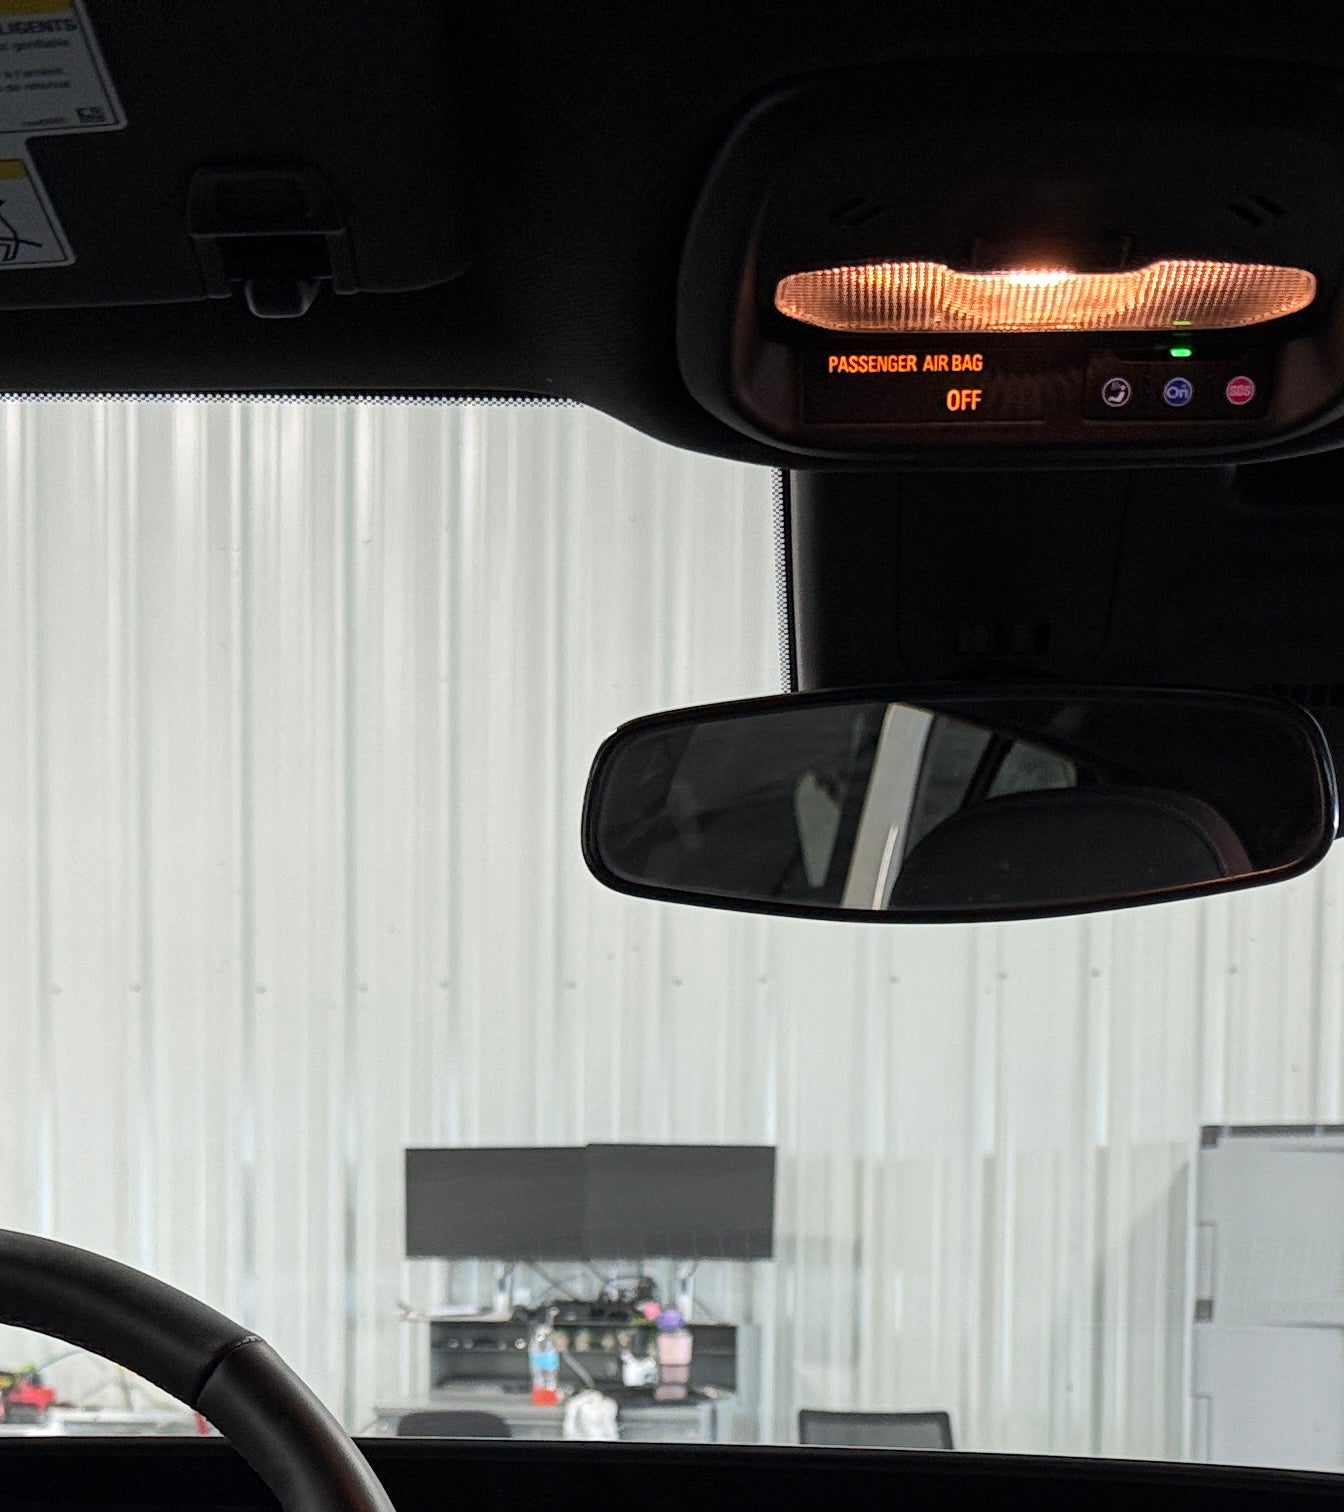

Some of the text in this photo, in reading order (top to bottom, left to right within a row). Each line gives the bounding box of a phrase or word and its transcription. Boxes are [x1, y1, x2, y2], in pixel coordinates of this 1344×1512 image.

[828, 354, 984, 373] PASSENGER AIR BAG
[946, 389, 983, 411] OFF
